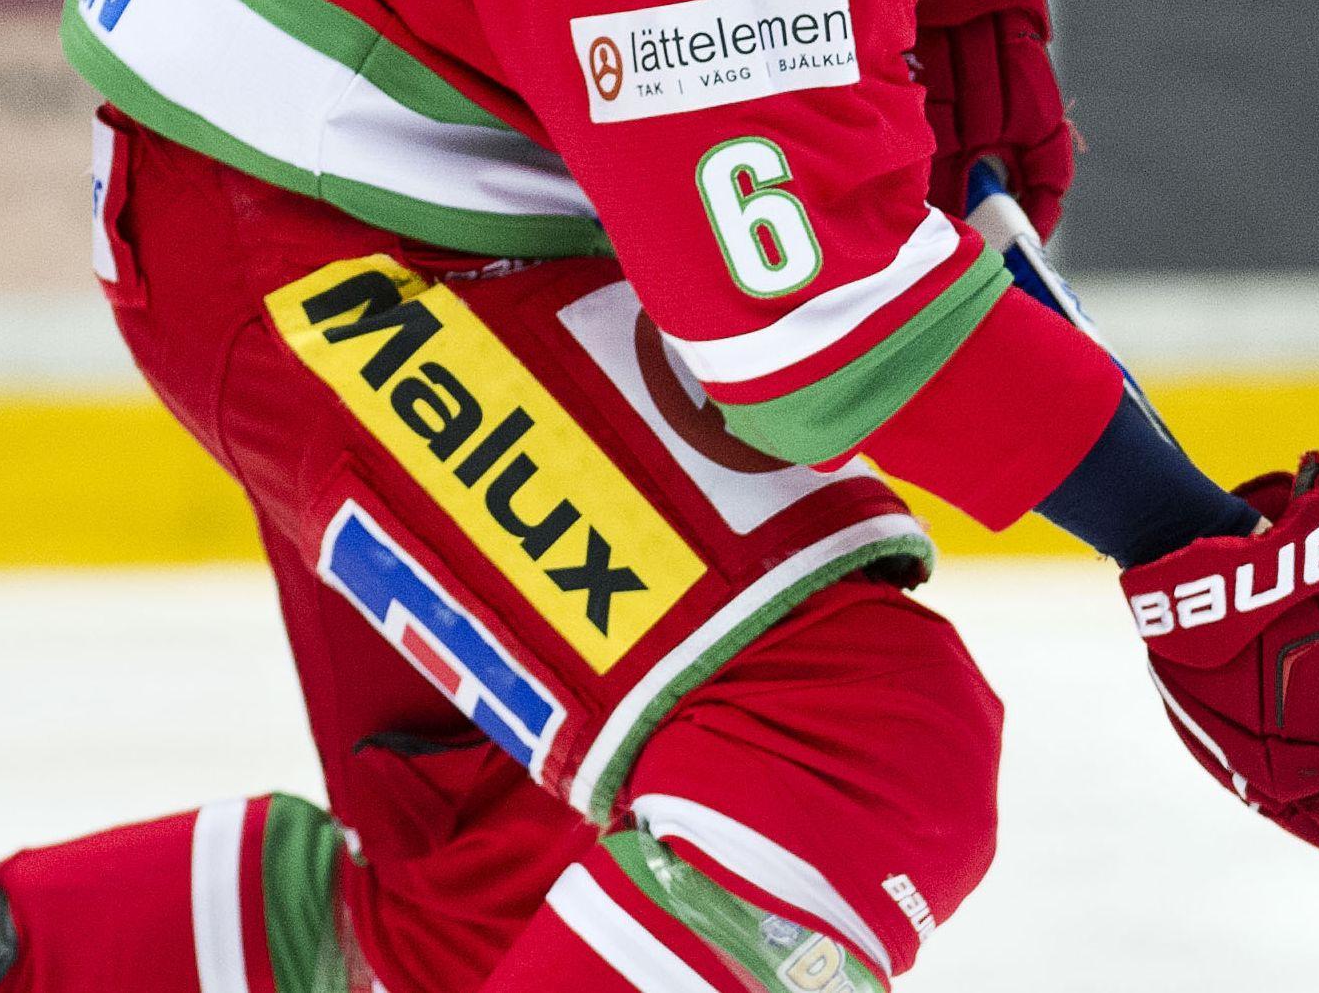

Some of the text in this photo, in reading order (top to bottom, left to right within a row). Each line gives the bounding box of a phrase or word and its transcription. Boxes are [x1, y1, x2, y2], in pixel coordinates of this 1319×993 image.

[637, 83, 664, 98] TAK
[699, 67, 752, 88] VÄGG
[694, 135, 824, 300] 6
[300, 269, 650, 637] Malux
